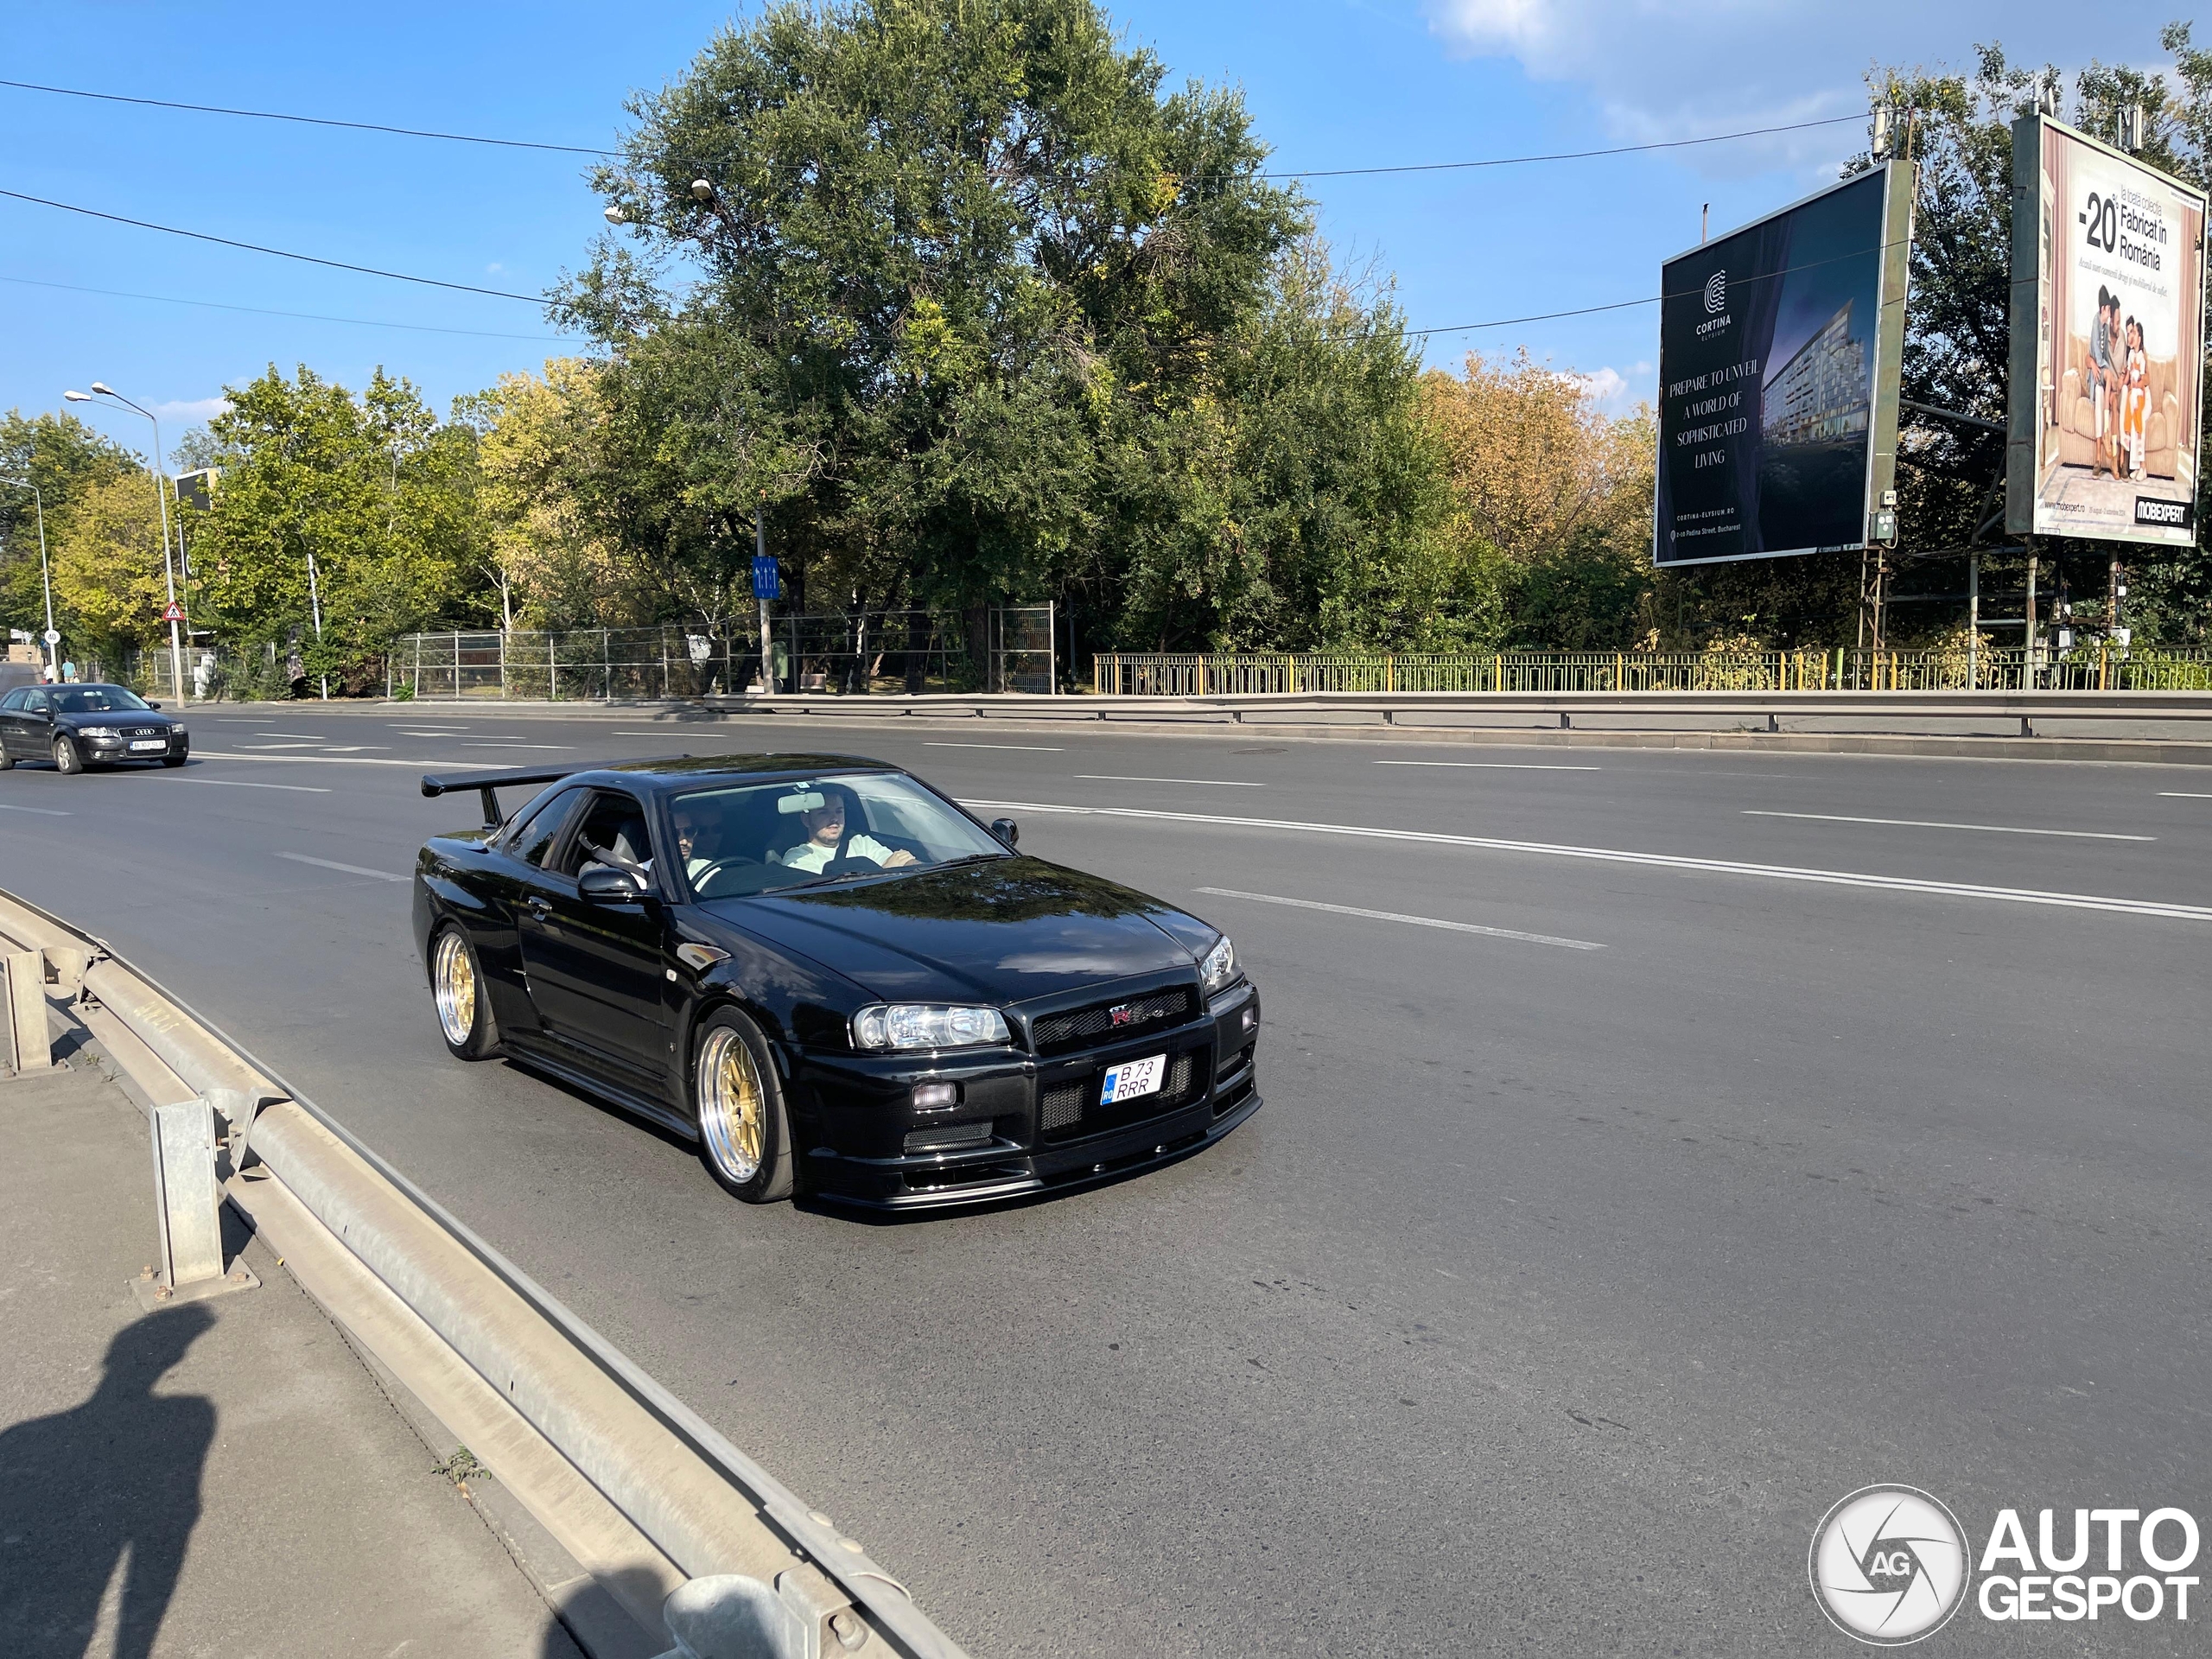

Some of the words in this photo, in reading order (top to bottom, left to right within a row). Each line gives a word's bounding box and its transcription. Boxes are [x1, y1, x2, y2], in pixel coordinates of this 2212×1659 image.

[2120, 204, 2157, 241] Fabricat
[2158, 219, 2167, 245] în
[2120, 234, 2160, 271] România
[1696, 315, 1731, 335] CORTINA
[1701, 329, 1725, 342] ELYSIUM
[1669, 374, 1708, 397] PREPARE
[1711, 370, 1723, 386] TO
[1726, 359, 1760, 382] UNVEIL
[1683, 405, 1690, 420] A
[1692, 396, 1726, 416] WORLD
[1728, 391, 1742, 408] OF
[1676, 416, 1747, 447] SOPHISTICATED
[1695, 449, 1725, 468] LIVING
[1676, 507, 1735, 522] CORTINA-ELYSIUM.RO
[2044, 501, 2085, 514] www.mobexpert.ro
[2137, 501, 2185, 523] MOBEXPERT
[1718, 524, 1740, 533] Bucharest
[1121, 1066, 1132, 1082] B
[1135, 1061, 1154, 1078] 73
[1103, 1090, 1113, 1101] RO
[1116, 1078, 1149, 1099] RRR
